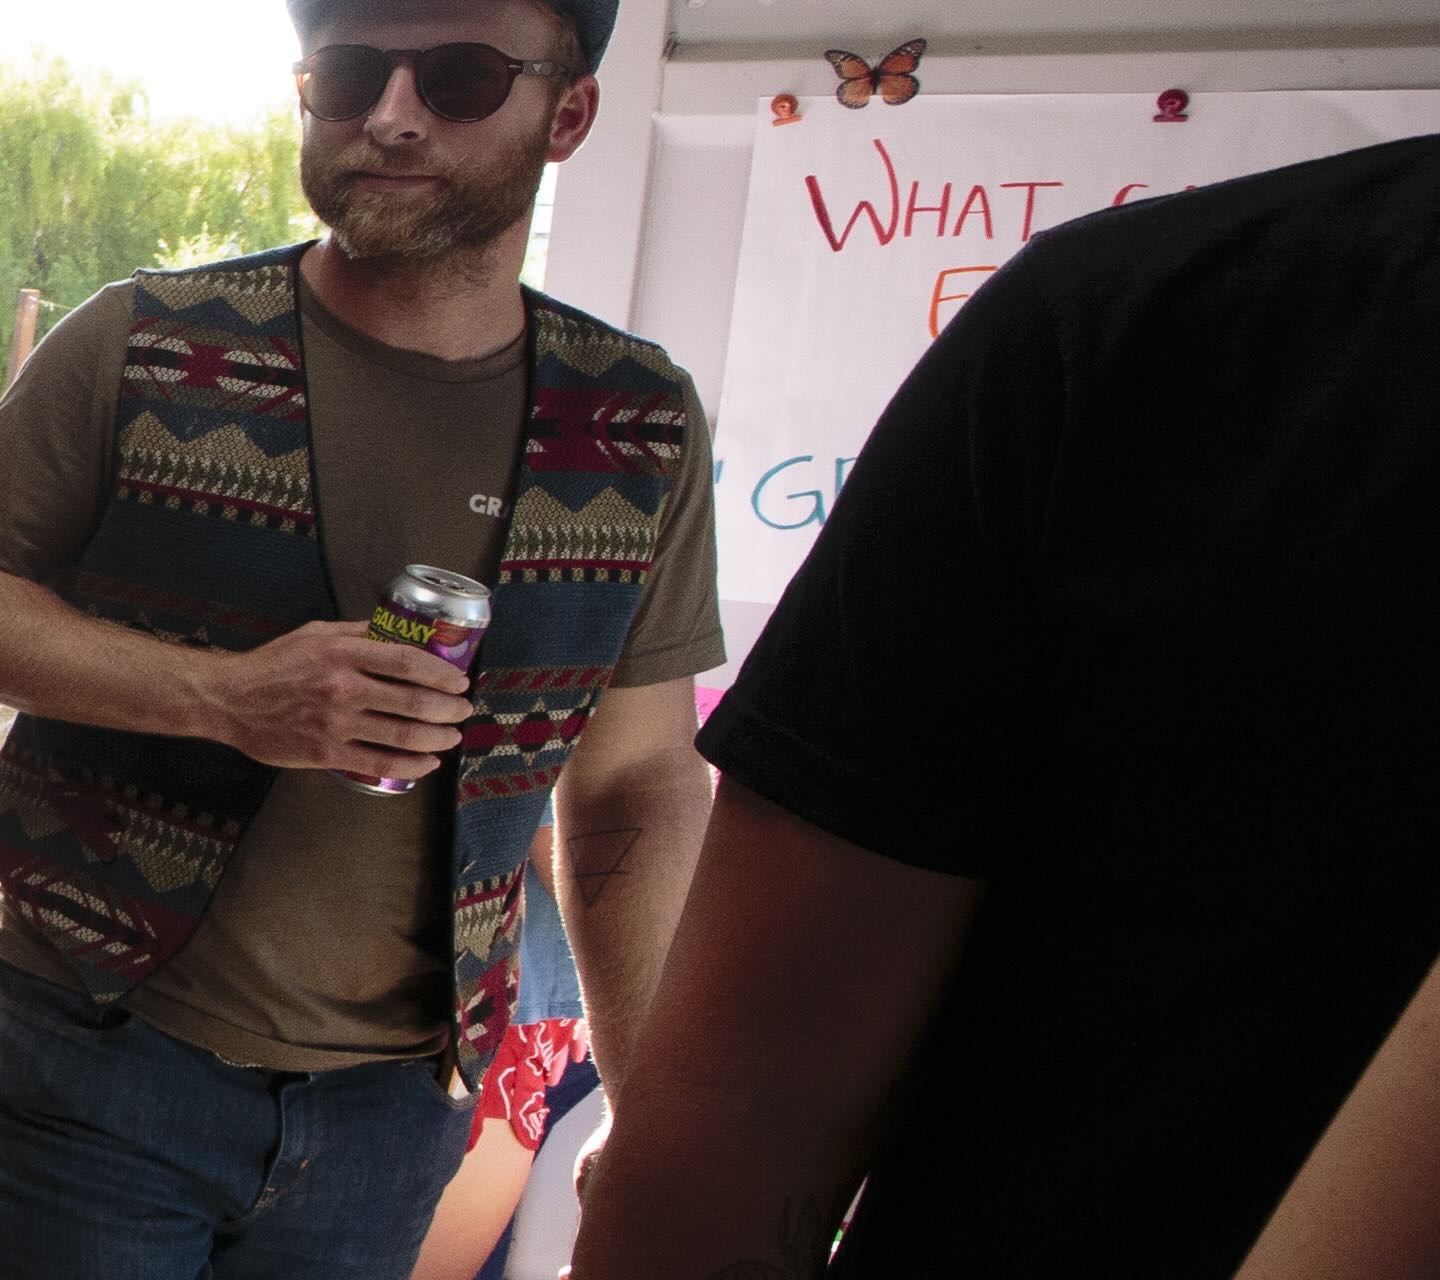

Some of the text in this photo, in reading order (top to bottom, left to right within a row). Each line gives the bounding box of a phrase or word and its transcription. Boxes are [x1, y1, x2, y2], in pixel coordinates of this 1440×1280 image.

[805, 138, 1064, 252] WHAT
[469, 493, 508, 517] GR
[373, 607, 437, 644] GALAXY
